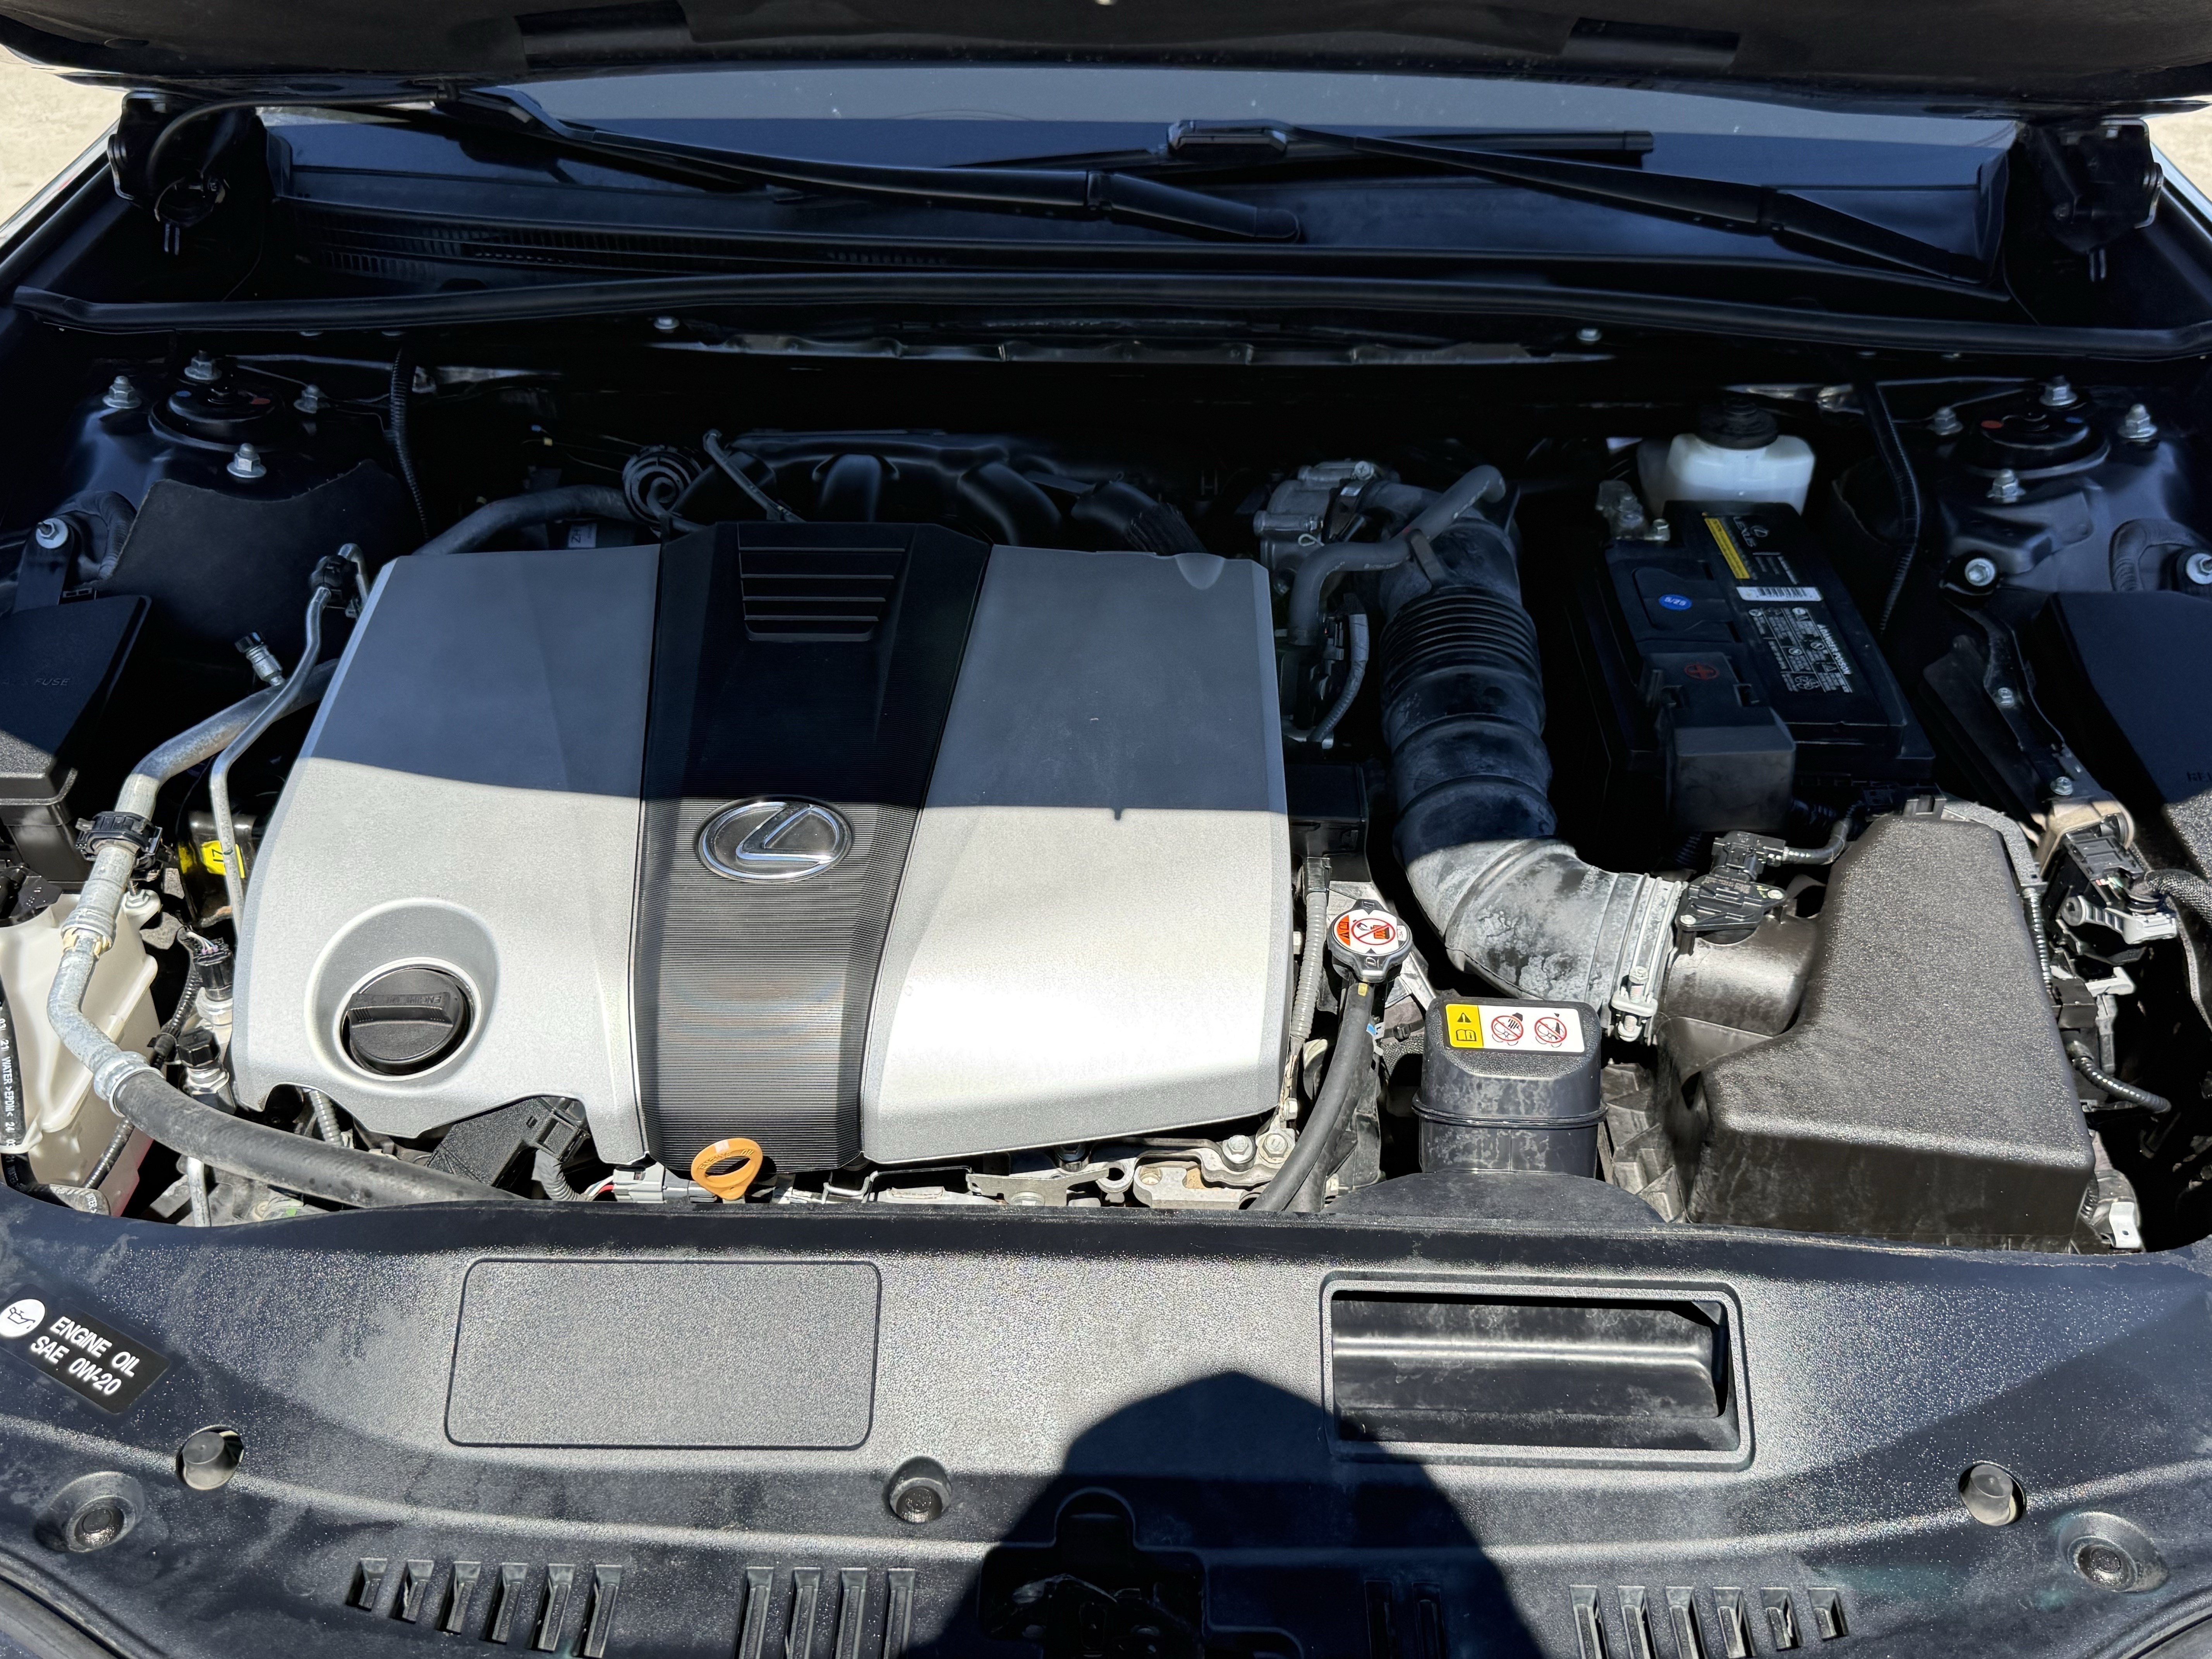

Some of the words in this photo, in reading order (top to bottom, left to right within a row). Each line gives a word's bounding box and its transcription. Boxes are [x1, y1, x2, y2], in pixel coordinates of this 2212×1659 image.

[1832, 652, 1851, 675] POISON
[35, 678, 71, 686] FUSE
[2, 1056, 13, 1085] WATER
[5, 1086, 15, 1117] >EPDM<
[698, 1152, 731, 1169] ENGINE
[50, 1316, 112, 1358] ENGINE
[112, 1351, 141, 1377] OIL
[30, 1335, 70, 1365] SAE
[69, 1357, 122, 1395] 0W-20
